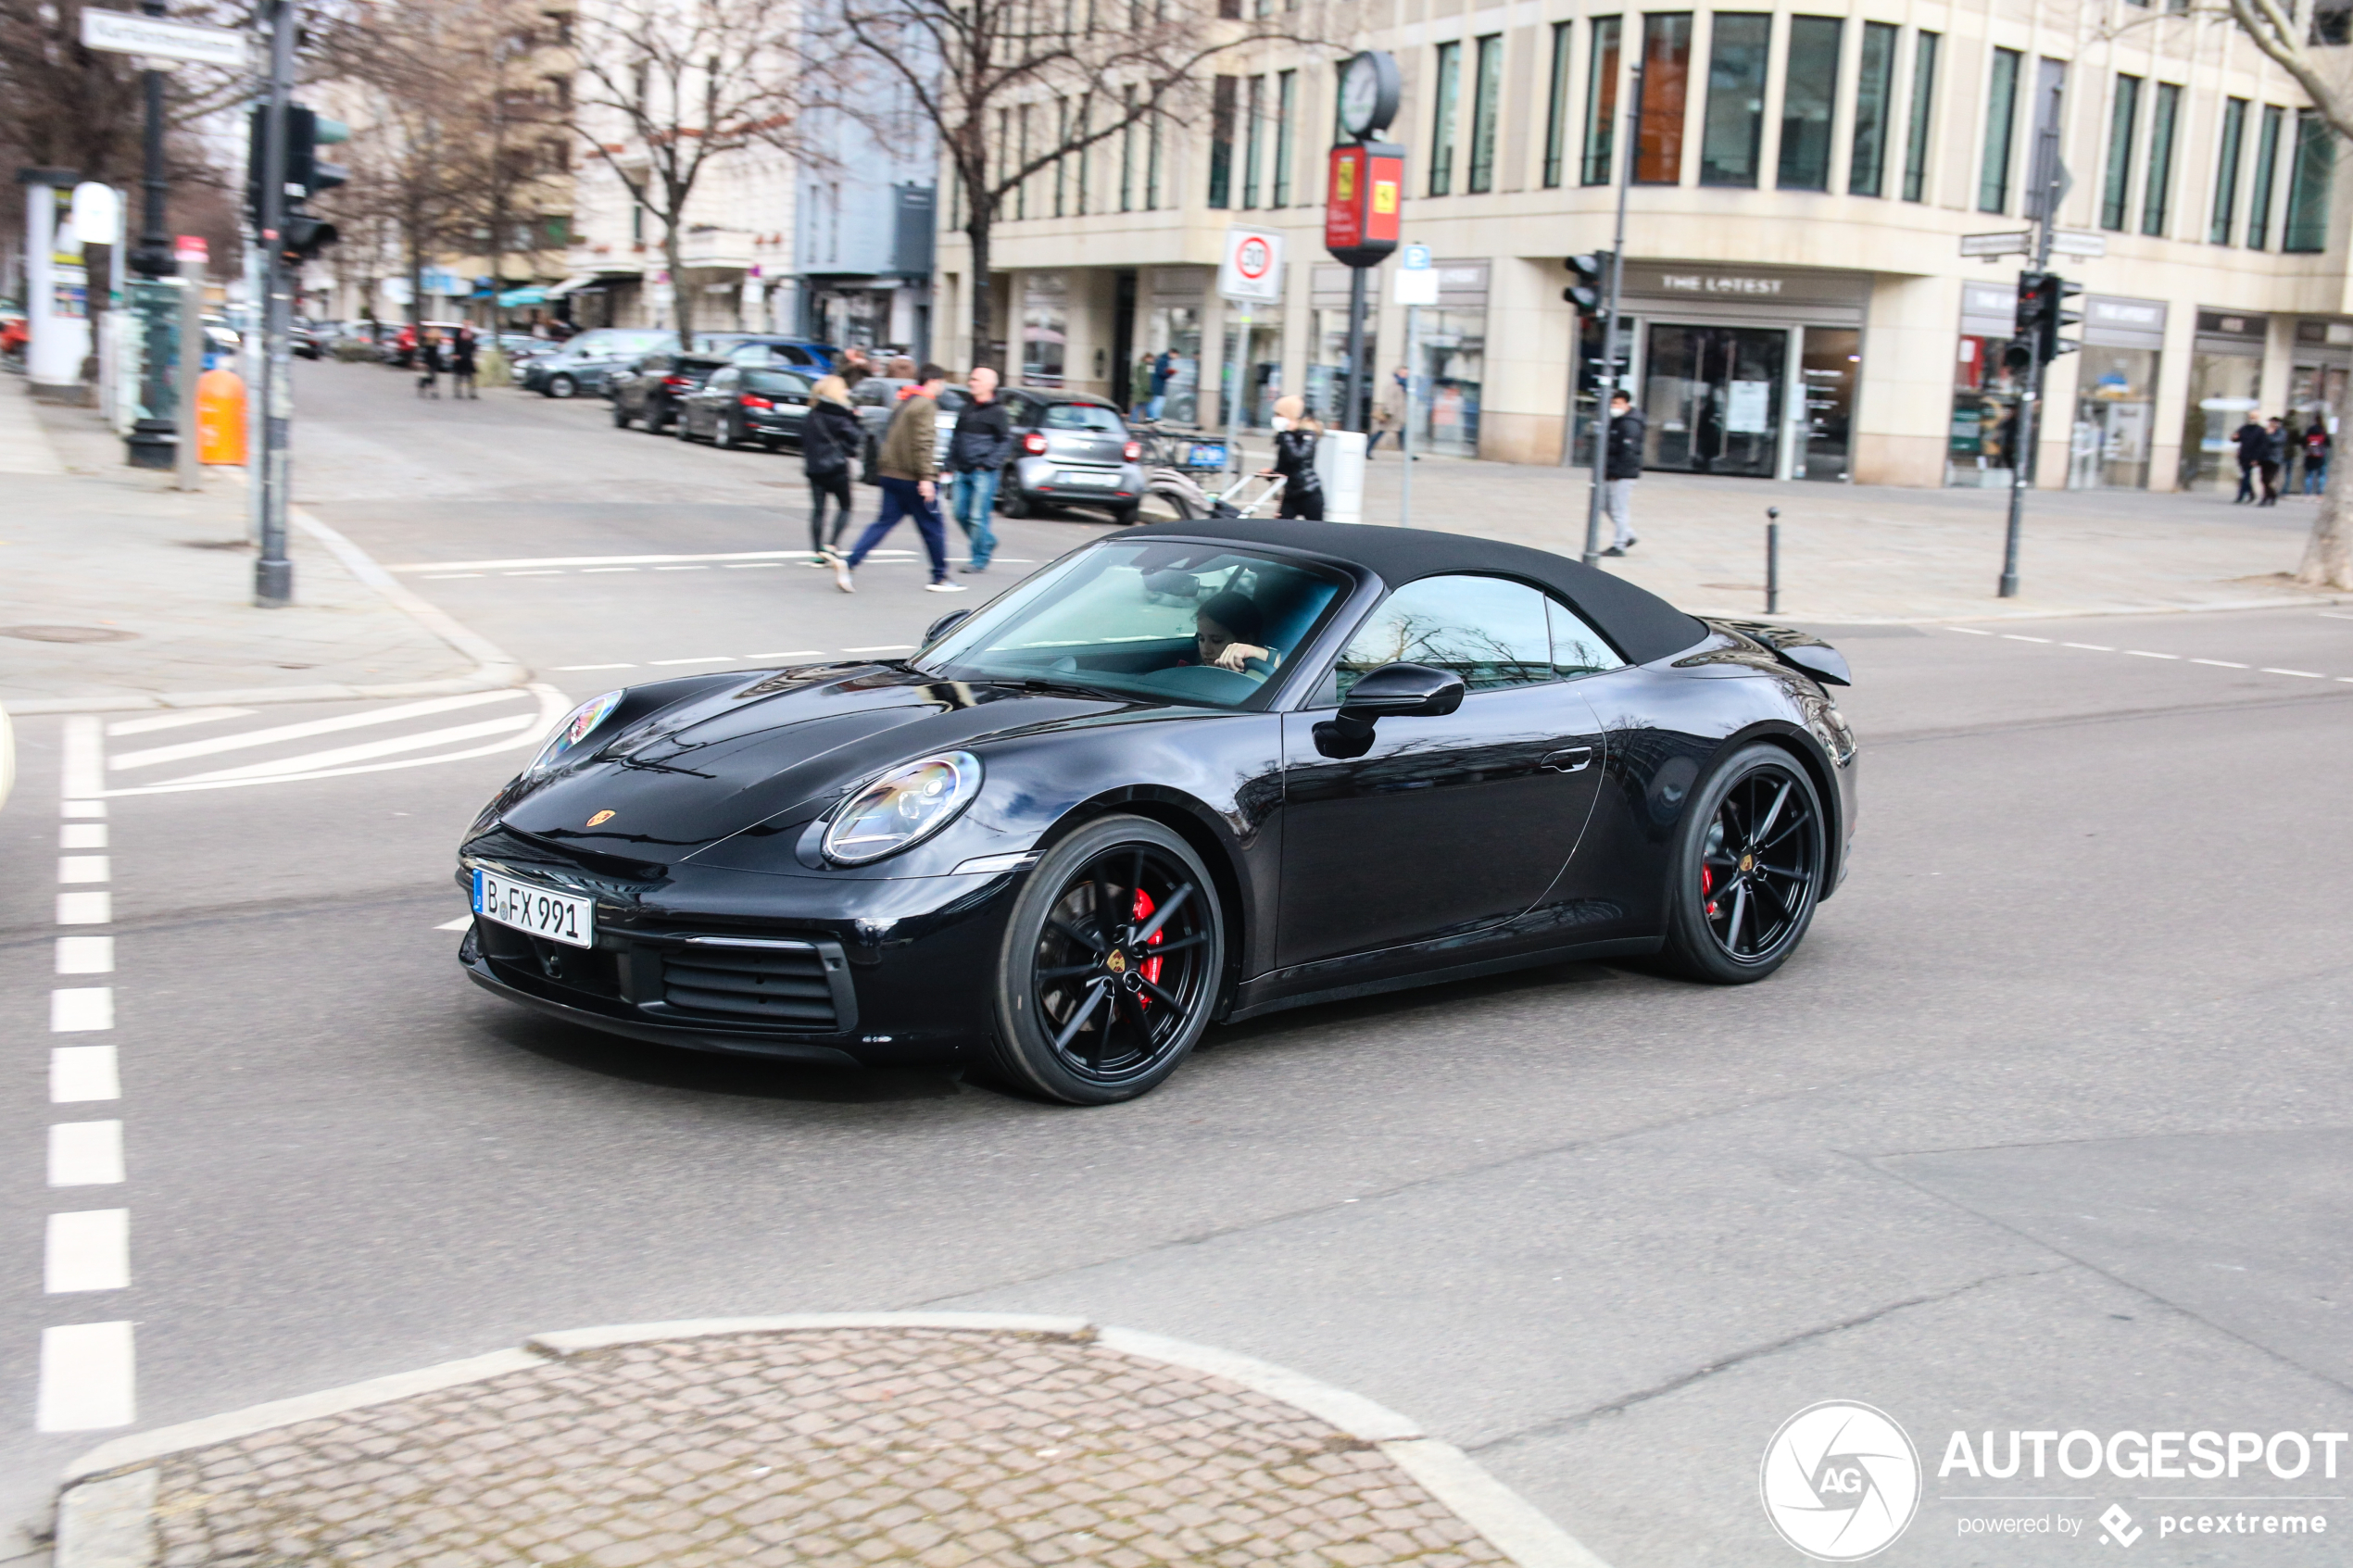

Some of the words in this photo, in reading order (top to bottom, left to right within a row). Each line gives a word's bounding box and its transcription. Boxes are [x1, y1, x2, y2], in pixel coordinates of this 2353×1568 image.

[1242, 247, 1265, 268] 30
[1663, 275, 1701, 291] THE
[488, 879, 498, 913] B
[510, 887, 533, 927] FX
[538, 896, 579, 938] 991
